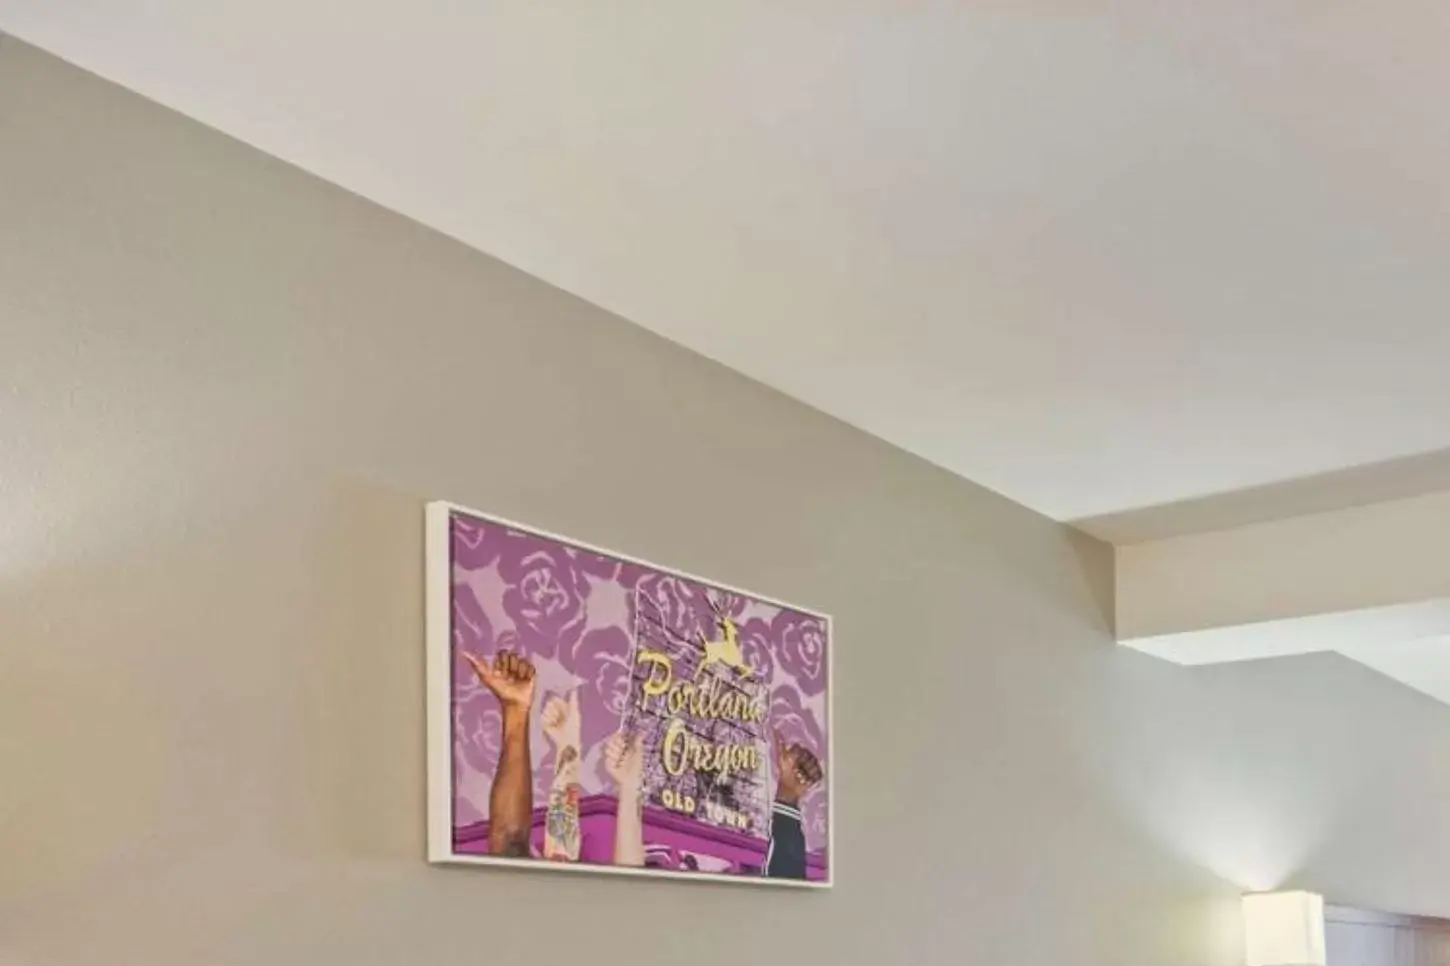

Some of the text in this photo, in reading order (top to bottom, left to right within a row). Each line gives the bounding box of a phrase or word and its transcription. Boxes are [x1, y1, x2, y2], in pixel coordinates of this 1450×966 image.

[638, 651, 766, 724] Portland
[663, 718, 757, 785] Oregon
[662, 789, 748, 829] OLD TOWN
